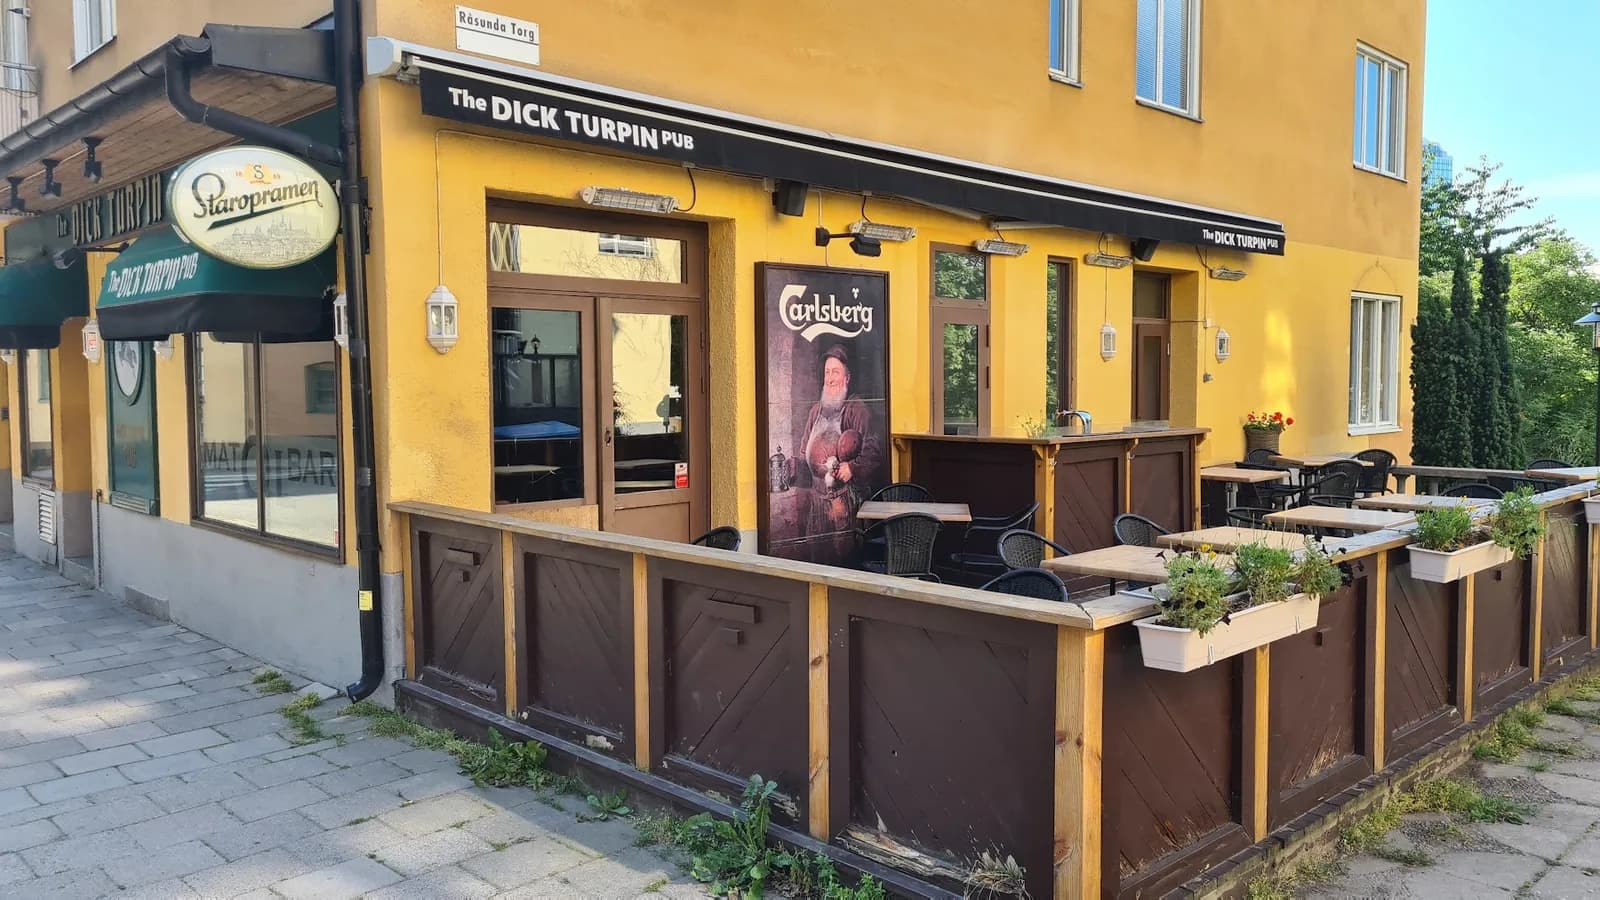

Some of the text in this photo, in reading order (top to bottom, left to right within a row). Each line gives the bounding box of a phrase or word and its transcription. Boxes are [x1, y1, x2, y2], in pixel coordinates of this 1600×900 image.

[459, 11, 535, 41] Råsunda Torg
[448, 86, 694, 150] The DICK TURPIN PUB
[56, 173, 162, 245] The DICK TURPIN
[191, 172, 323, 218] Staropramen
[1202, 229, 1279, 250] The DICK TURPIN PUB
[108, 252, 200, 298] The DICK TURPIN PUB
[779, 284, 874, 343] Carlsberg
[202, 442, 241, 473] MAT
[287, 447, 338, 488] BAR
